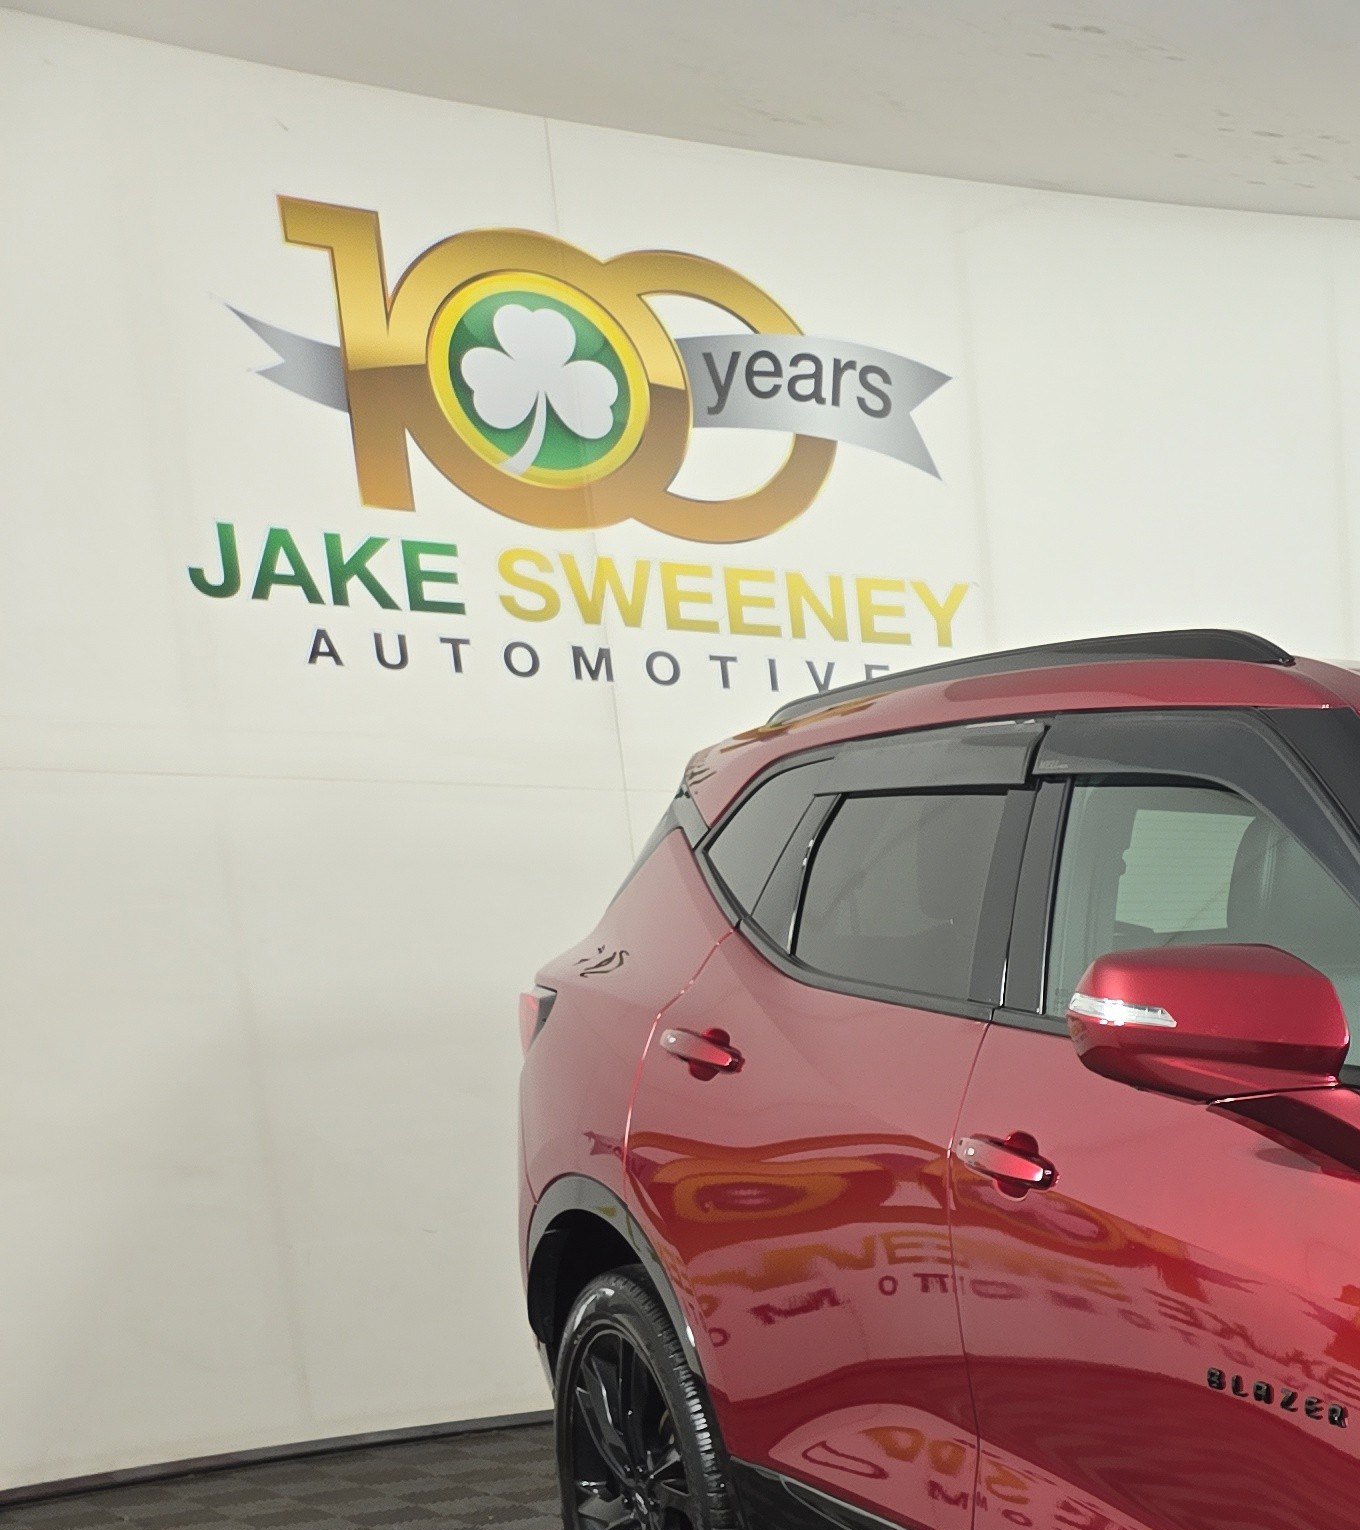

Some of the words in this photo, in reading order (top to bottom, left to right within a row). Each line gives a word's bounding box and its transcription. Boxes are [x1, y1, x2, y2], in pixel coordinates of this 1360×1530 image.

[702, 348, 894, 420] years
[187, 521, 467, 616] JAKE
[497, 547, 970, 649] SWEENEY
[1206, 1367, 1349, 1429] BLAZER
